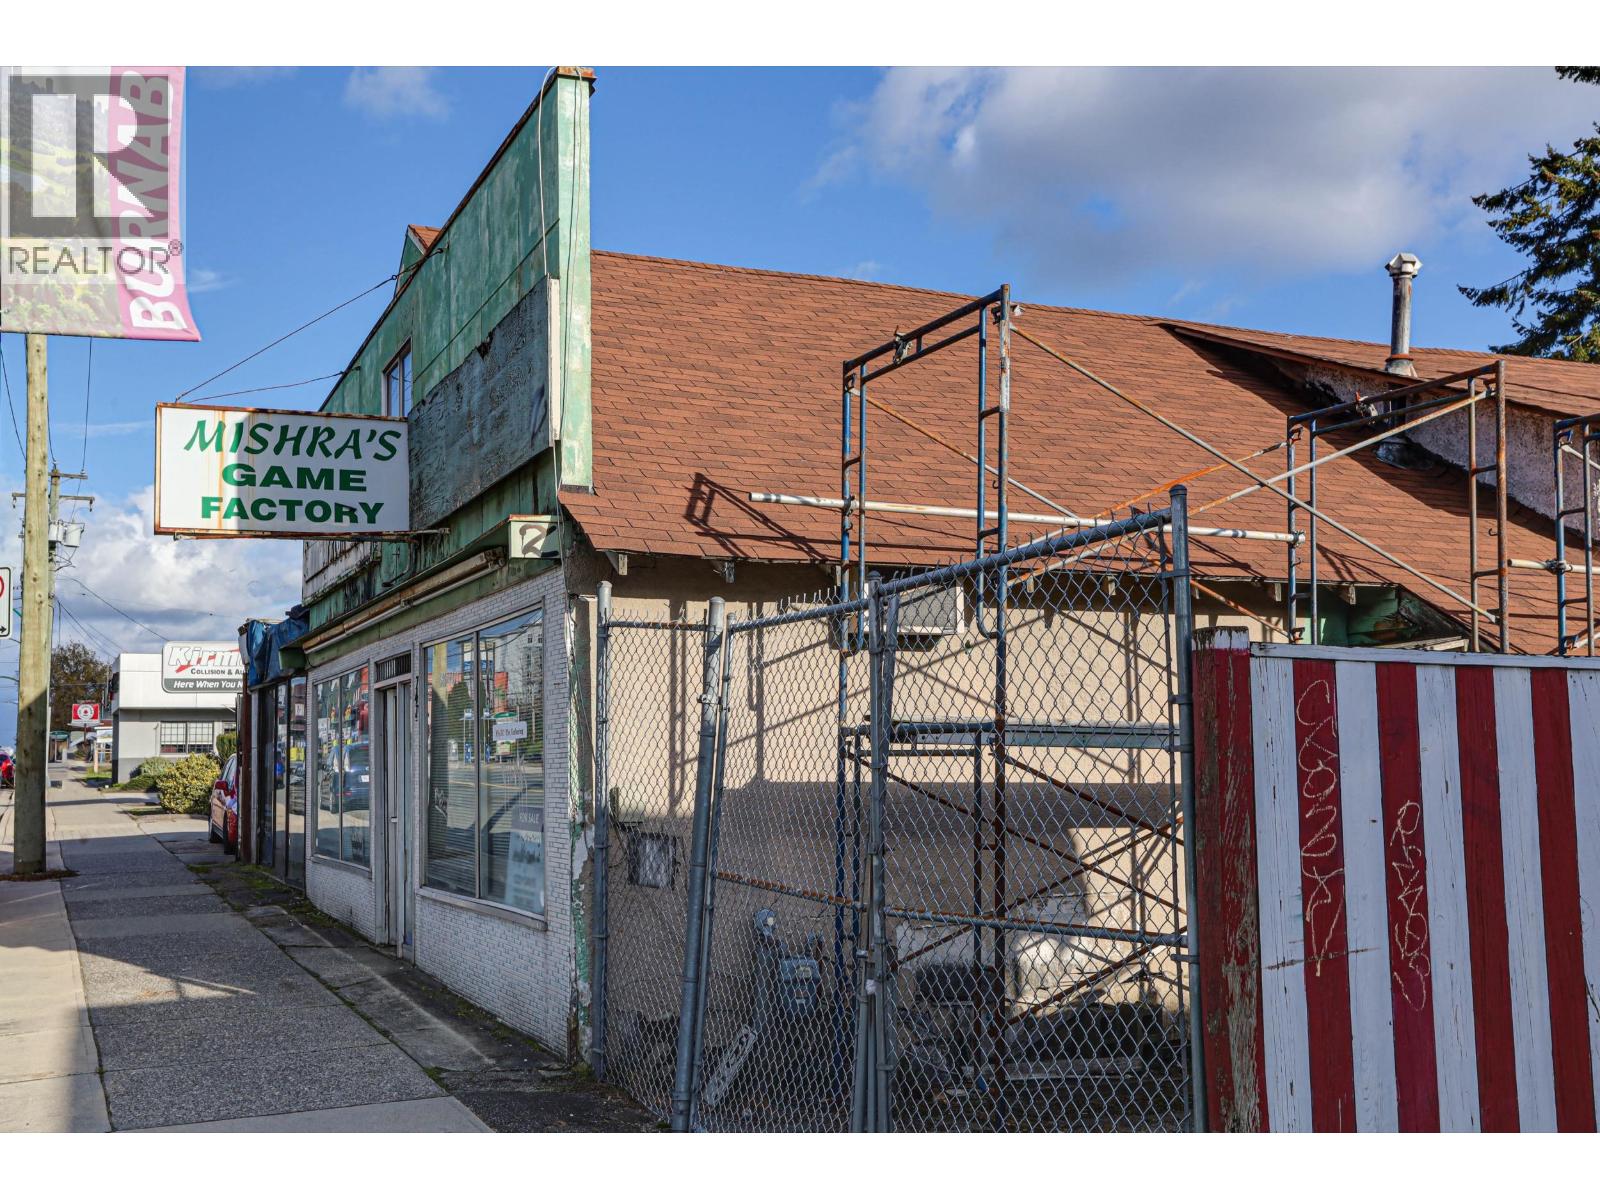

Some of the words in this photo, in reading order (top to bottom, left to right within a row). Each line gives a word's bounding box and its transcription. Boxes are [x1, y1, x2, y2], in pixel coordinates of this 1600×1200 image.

[183, 419, 402, 461] MISHRA'S
[221, 463, 367, 492] GAME
[201, 496, 384, 524] FACTORY
